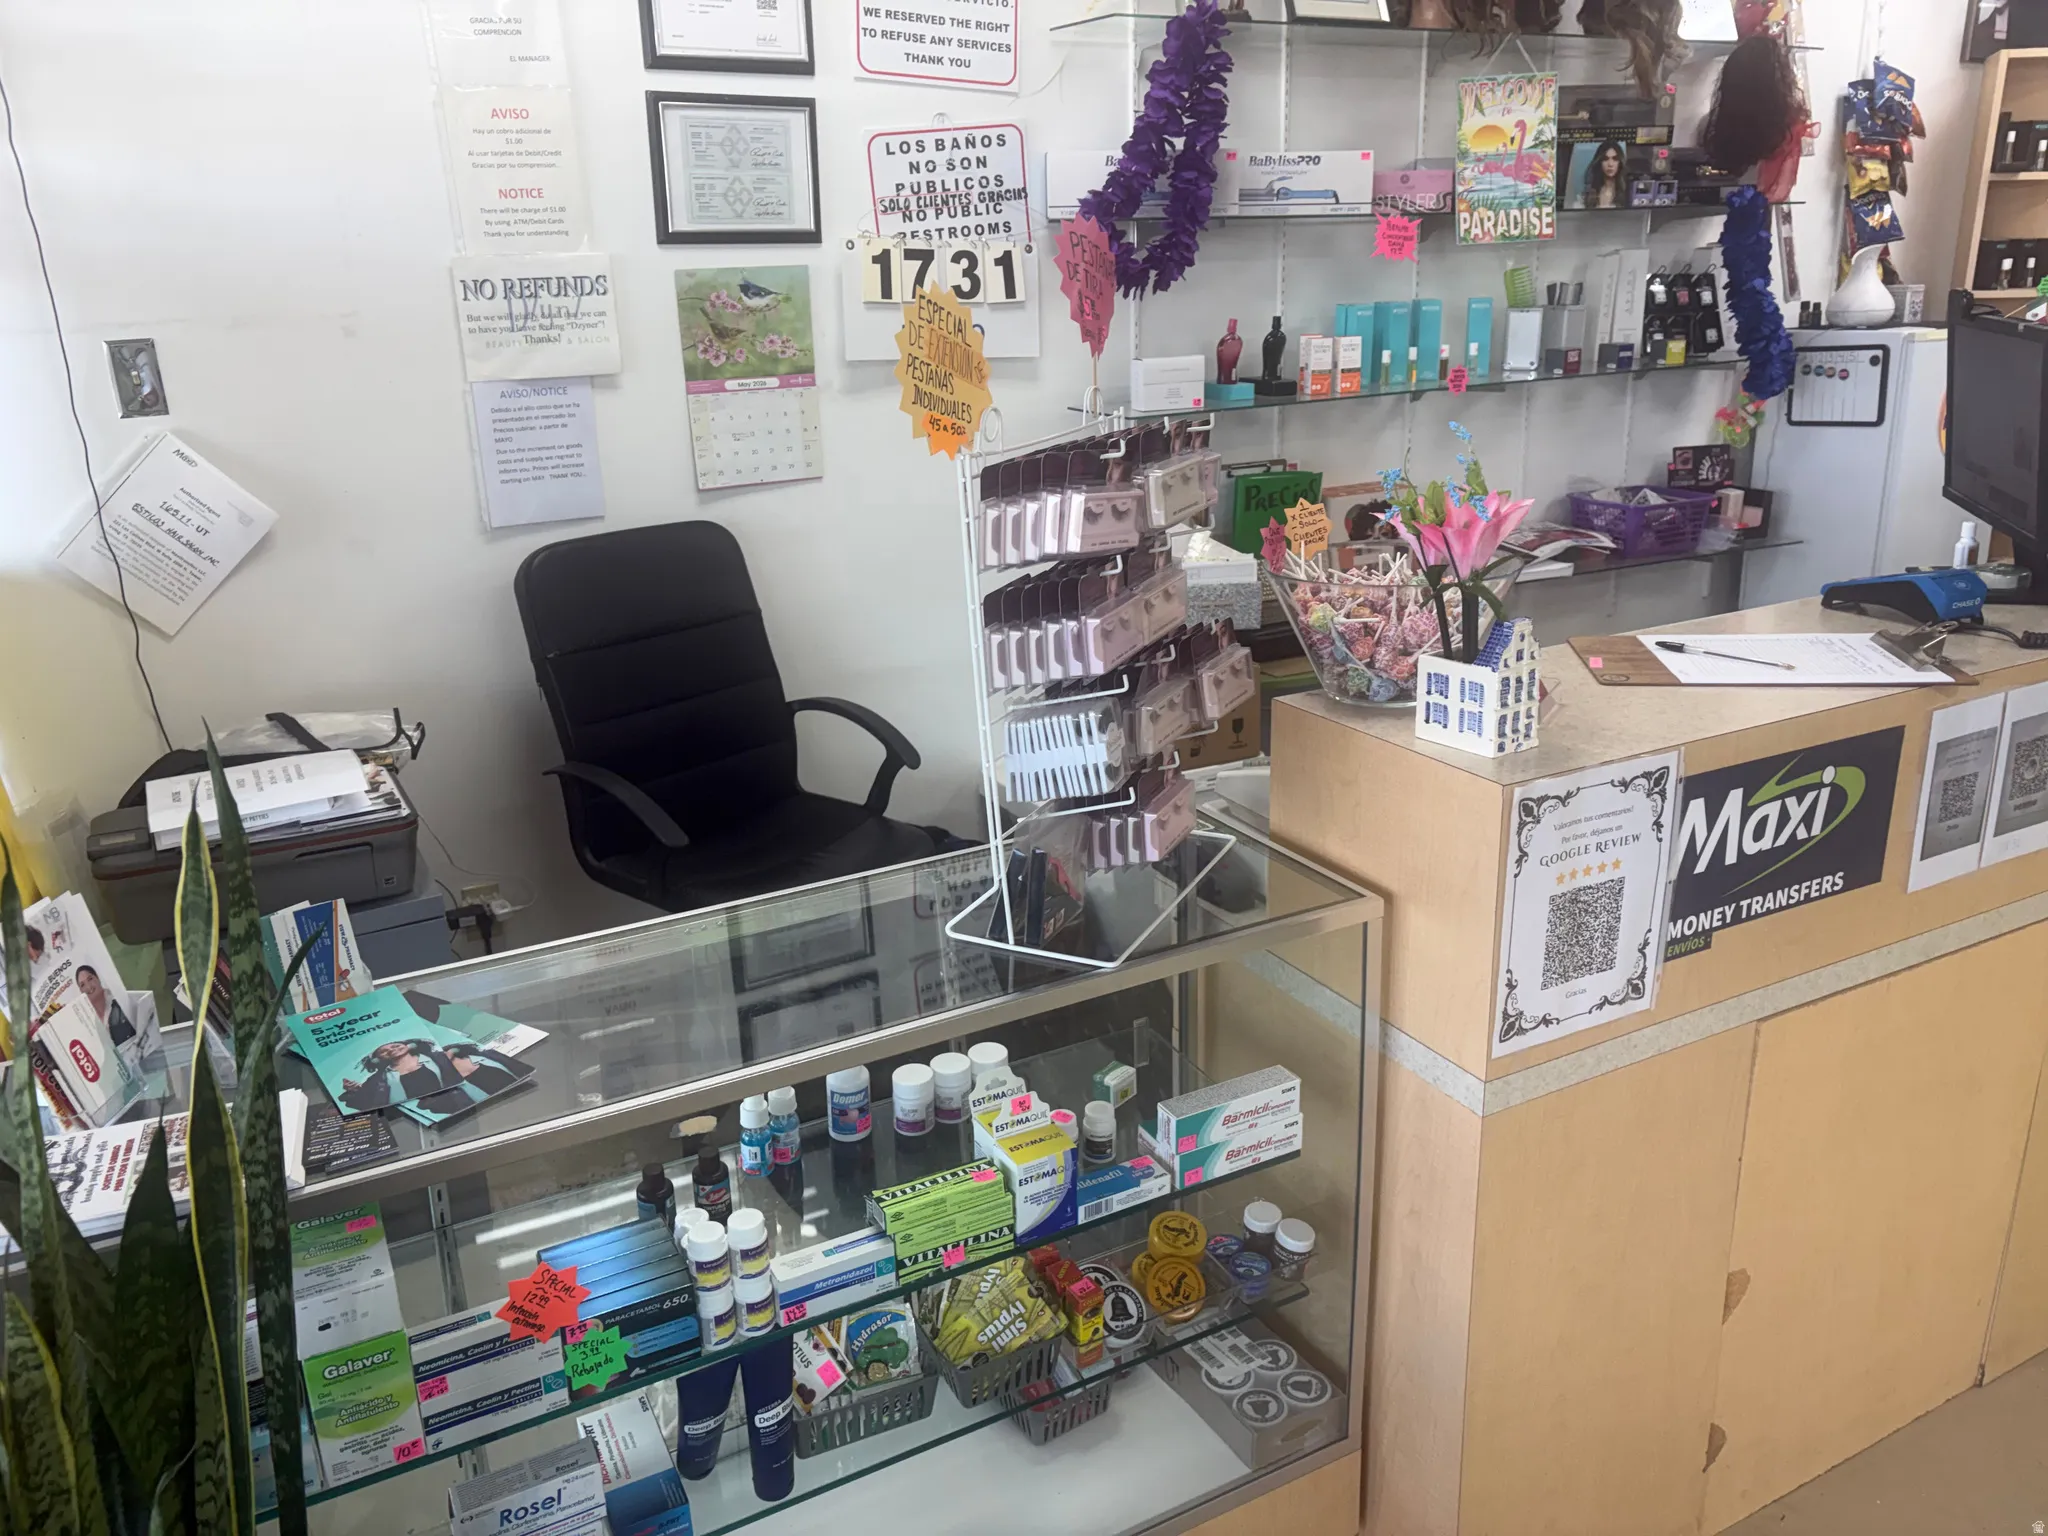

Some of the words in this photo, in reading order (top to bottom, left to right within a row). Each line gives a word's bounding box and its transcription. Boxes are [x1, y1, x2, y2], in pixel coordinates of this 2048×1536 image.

[863, 7, 881, 18] WE
[885, 10, 946, 25] RESERVED
[949, 18, 971, 28] THE
[975, 21, 1010, 33] RIGHT
[862, 28, 877, 38] TO
[881, 30, 926, 43] REFUSE
[930, 36, 953, 46] ANY
[957, 39, 1011, 53] SERVICES
[904, 53, 944, 65] THANK
[948, 57, 971, 68] YOU
[1459, 78, 1556, 122] WELCOME
[491, 108, 529, 119] AVISO
[886, 140, 926, 155] LOS
[935, 133, 1007, 152] BAÑOS
[909, 160, 937, 175] NO
[946, 155, 988, 171] SON
[498, 188, 544, 199] NOTICE
[895, 174, 1004, 197] PUBLICOS
[880, 198, 910, 213] SOLO
[916, 192, 972, 209] CLIENTES
[978, 187, 1028, 203] GRACIAS
[1376, 193, 1436, 210] STYLER
[903, 210, 927, 223] NO
[935, 202, 1003, 220] PUBLIC
[1459, 206, 1553, 240] PARADISE
[898, 221, 1012, 240] RESTROOMS
[1066, 260, 1081, 282] DE
[460, 279, 497, 301] NO
[501, 275, 608, 300] REFUNDS
[467, 314, 481, 322] But
[918, 294, 972, 348] ESPECIAL
[523, 334, 561, 344] Thanks!
[909, 320, 924, 350] DE
[974, 361, 985, 384] DE
[906, 353, 954, 395] PESTAÑAS
[500, 386, 568, 399] AVISO/NOTICE
[912, 384, 972, 424] INDIVIDUALES
[929, 415, 941, 432] 45
[179, 486, 206, 508] Authorized
[205, 505, 221, 519] Agent
[1299, 508, 1325, 519] CLIENTE
[1294, 526, 1328, 542] CLIENTES
[1952, 600, 1975, 609] CHASE
[1553, 818, 1582, 831] Valoramos
[1595, 805, 1634, 821] comentarios!
[1673, 764, 1836, 875] Maxi
[1561, 836, 1571, 844] Por
[1572, 832, 1589, 841] favor,
[1590, 826, 1614, 837] déjanos
[1540, 844, 1591, 867] GOOGLE
[1595, 833, 1642, 853] REVIEW
[1667, 903, 1737, 942] MONEY
[1740, 871, 1845, 919] TRANSFERS
[1667, 936, 1705, 957] ENVÍOS
[47, 959, 73, 982] BUENOS
[1565, 986, 1588, 1000] Gracias
[309, 1009, 341, 1022] total
[315, 1027, 356, 1043] price
[318, 1019, 401, 1048] guarantee
[71, 1044, 97, 1080] total
[1222, 1102, 1270, 1126] Barmicil
[1225, 1137, 1272, 1161] Barmicil
[880, 1163, 992, 1201] VITACILINA
[1077, 1170, 1124, 1190] ildenafil
[297, 1206, 362, 1229] Galaver
[533, 1269, 576, 1299] SPECIAL
[814, 1266, 873, 1290] Metronidazol
[605, 1303, 661, 1325] PARACETAMOL
[662, 1294, 689, 1309] 650
[851, 1313, 893, 1351] Hydrasor
[991, 1317, 1028, 1352] Simi
[571, 1337, 614, 1351] SPECIAL
[324, 1350, 390, 1379] Galaver
[418, 1354, 466, 1372] Neomicina,
[571, 1357, 614, 1377] Rebajado
[428, 1406, 473, 1425] Neomicina,
[504, 1392, 510, 1400] y
[511, 1382, 541, 1396] Pectina
[758, 1410, 781, 1424] Deep
[556, 1460, 578, 1473] Rosel
[500, 1488, 561, 1527] Rosel
